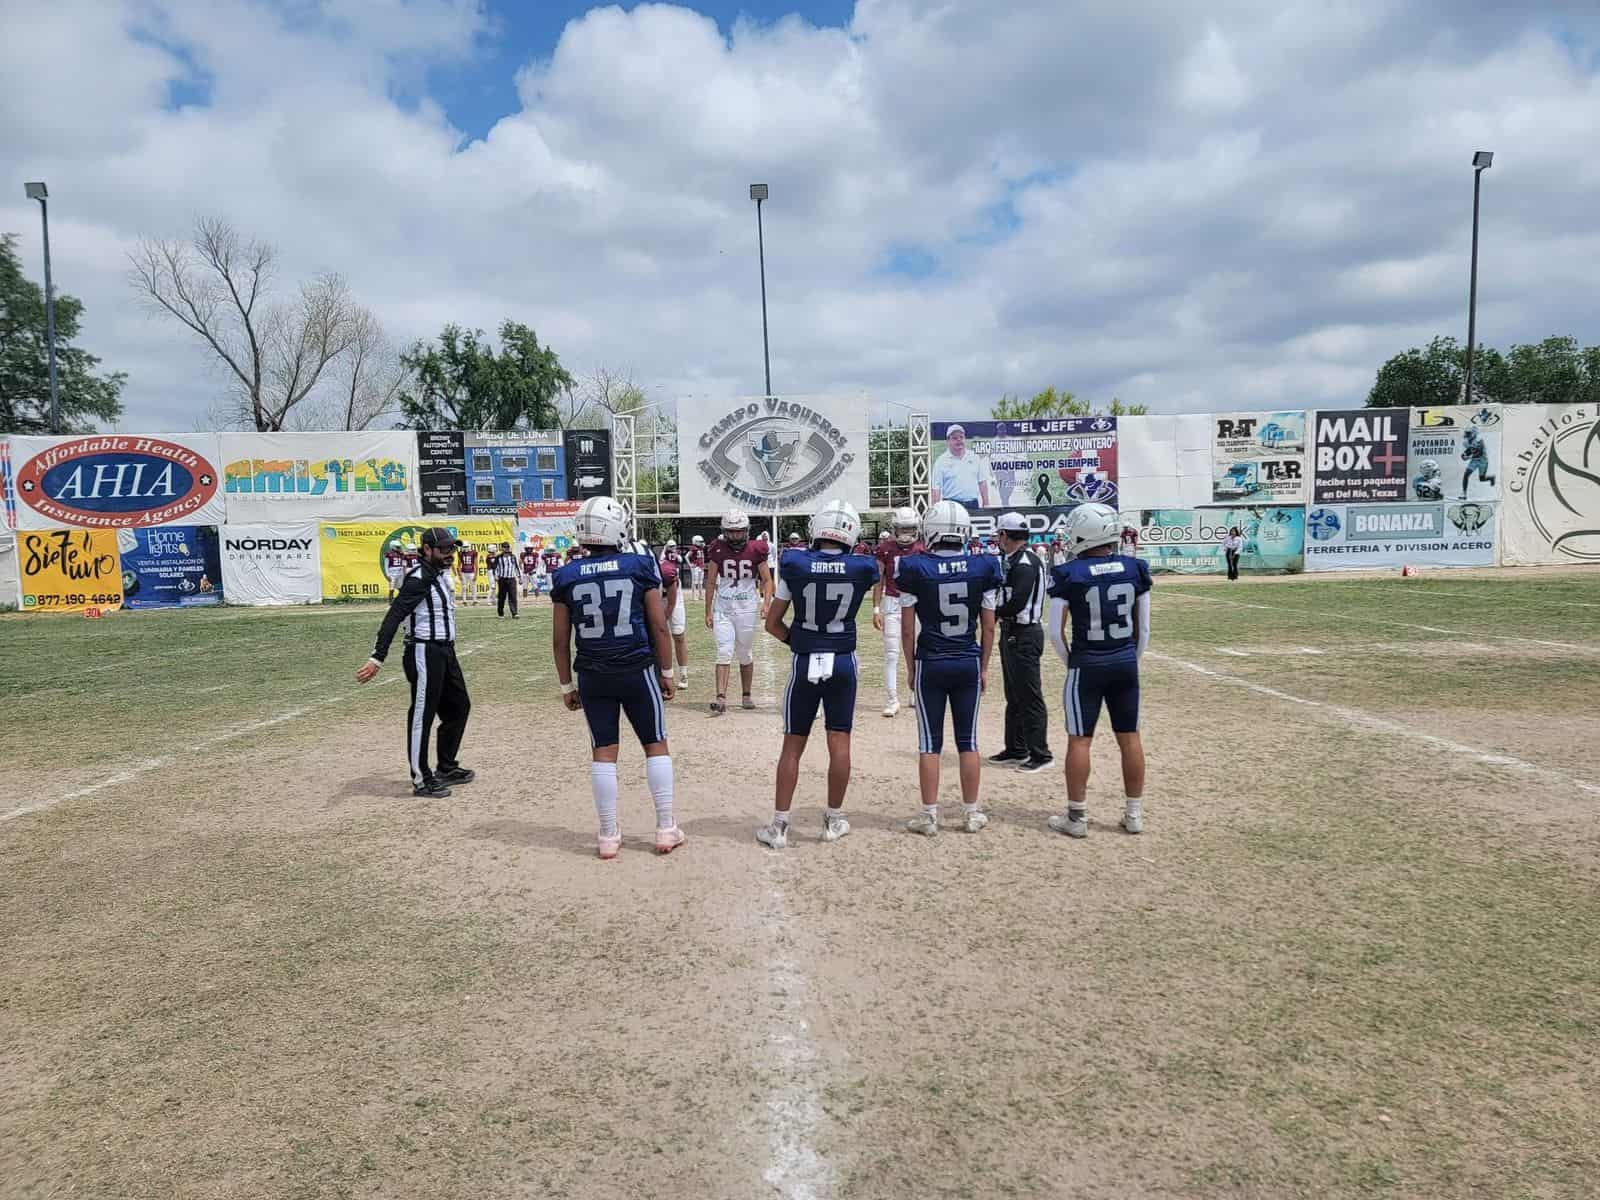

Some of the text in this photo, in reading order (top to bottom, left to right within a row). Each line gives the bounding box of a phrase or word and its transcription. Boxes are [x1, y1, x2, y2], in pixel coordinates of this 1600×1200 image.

[699, 398, 848, 449] CAMPO VAQUEROS
[1317, 416, 1398, 443] MAIL
[995, 440, 1024, 453] FERMIN
[1026, 438, 1072, 452] RODRIGUEZ
[1412, 439, 1455, 448] APOYANDO A
[1510, 409, 1585, 493] Caballos
[35, 438, 199, 475] Affordable Health
[991, 457, 1099, 471] VAQUERO POR SIEMPRE
[53, 462, 177, 500] AHIA
[1316, 478, 1345, 487] Recibe
[1363, 477, 1405, 488] paquetes
[1322, 490, 1334, 499] en
[1336, 489, 1350, 498] Del
[1371, 488, 1397, 497] Texas
[31, 493, 202, 526] Insurance Agency
[1356, 513, 1434, 532] BONANZA
[147, 529, 185, 543] Home
[25, 530, 78, 575] Siete
[149, 542, 179, 557] lights
[229, 553, 312, 561] DRINKWARE
[1307, 545, 1379, 554] FERRETERIA
[1395, 543, 1449, 552] DIVISION
[1452, 541, 1492, 550] ACERO
[69, 555, 115, 580] uno
[580, 560, 619, 575] REYNOSA
[723, 560, 753, 579] 66
[810, 562, 846, 574] SHREVE
[341, 584, 379, 595] DEL RIO
[38, 594, 121, 605] 877-190-4642
[572, 578, 634, 639] 37
[802, 582, 855, 633] 17
[938, 582, 969, 637] 5
[1085, 583, 1136, 641] 13
